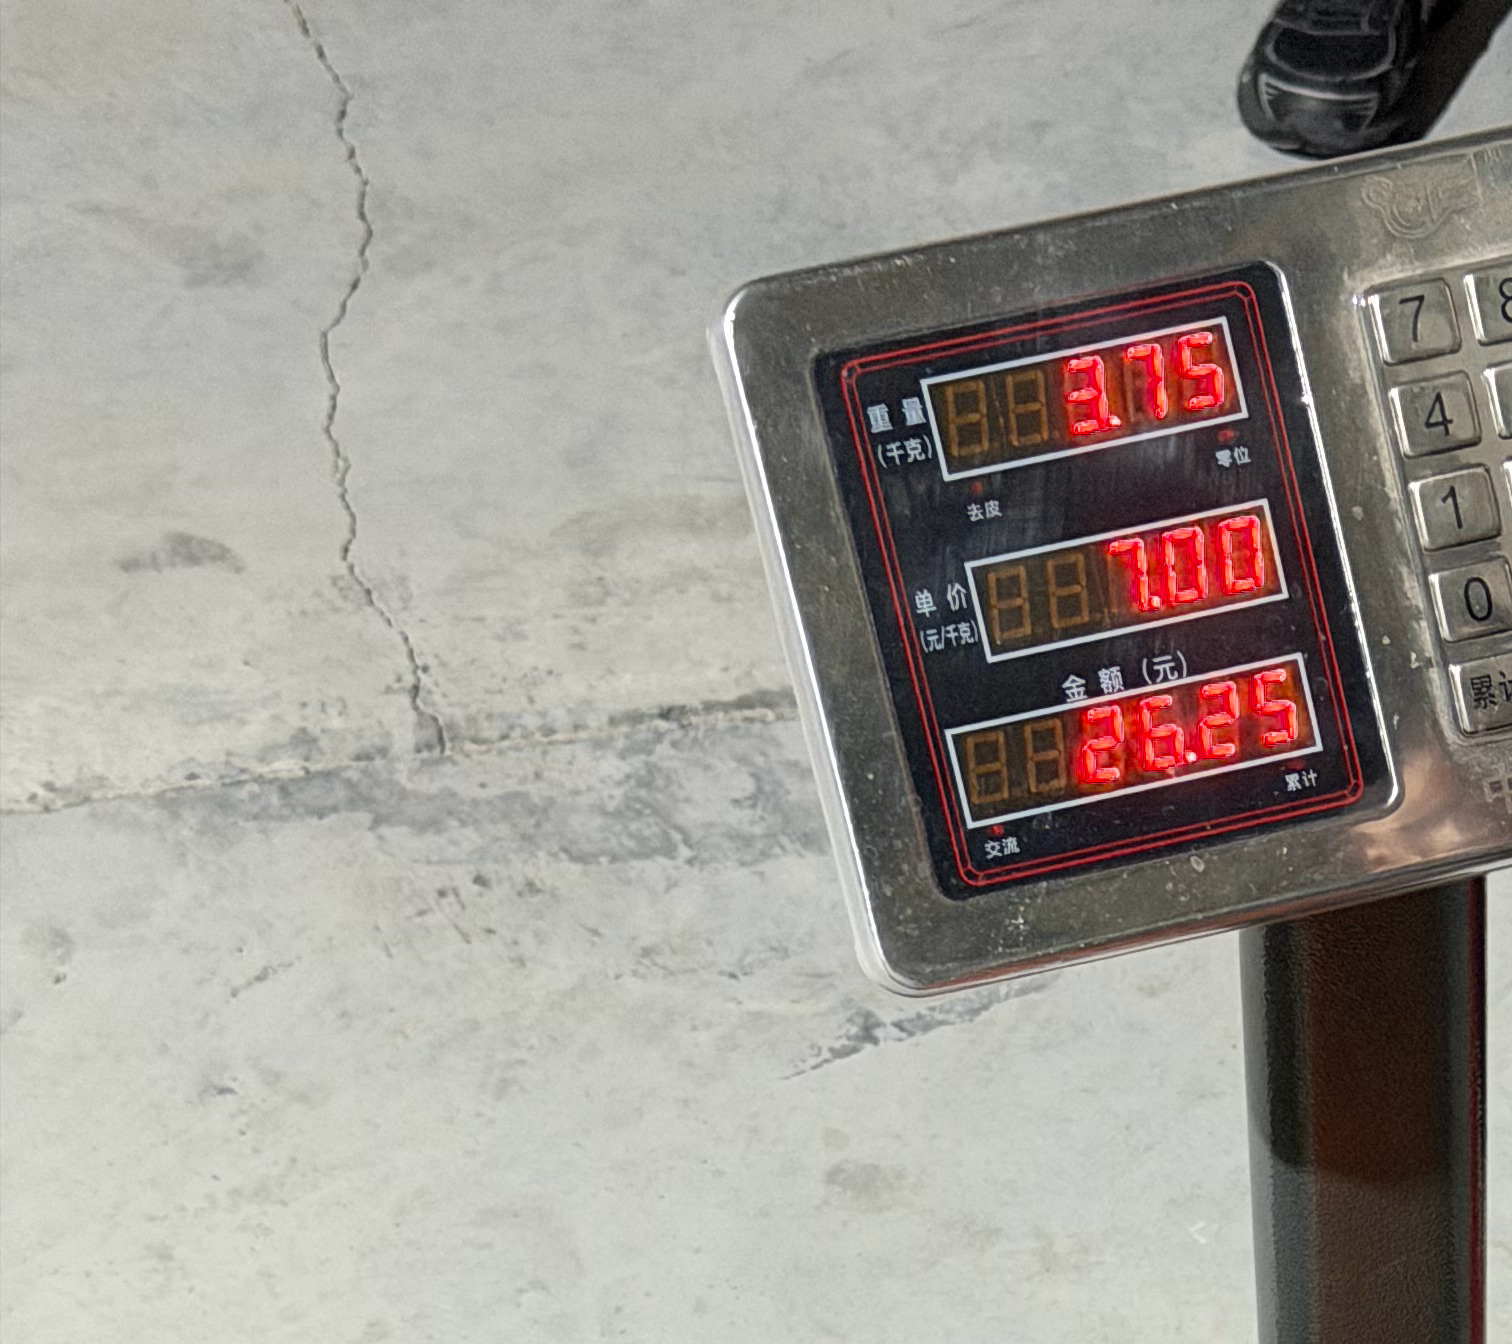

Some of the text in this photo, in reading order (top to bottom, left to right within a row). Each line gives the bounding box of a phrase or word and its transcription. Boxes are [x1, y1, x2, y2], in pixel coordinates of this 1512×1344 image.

[1398, 293, 1425, 343] 7
[1063, 331, 1227, 437] 3.75
[866, 396, 927, 433] 重量
[1424, 391, 1454, 437] 4
[966, 499, 1003, 522] 去皮
[1440, 484, 1464, 531] 1
[1107, 515, 1268, 613] 7.00
[913, 582, 969, 618] 单价
[1463, 576, 1494, 623] 0
[1061, 665, 1126, 703] 金额
[1077, 668, 1300, 785] 26.25
[1285, 772, 1319, 793] 累计
[983, 836, 1021, 858] 交流
